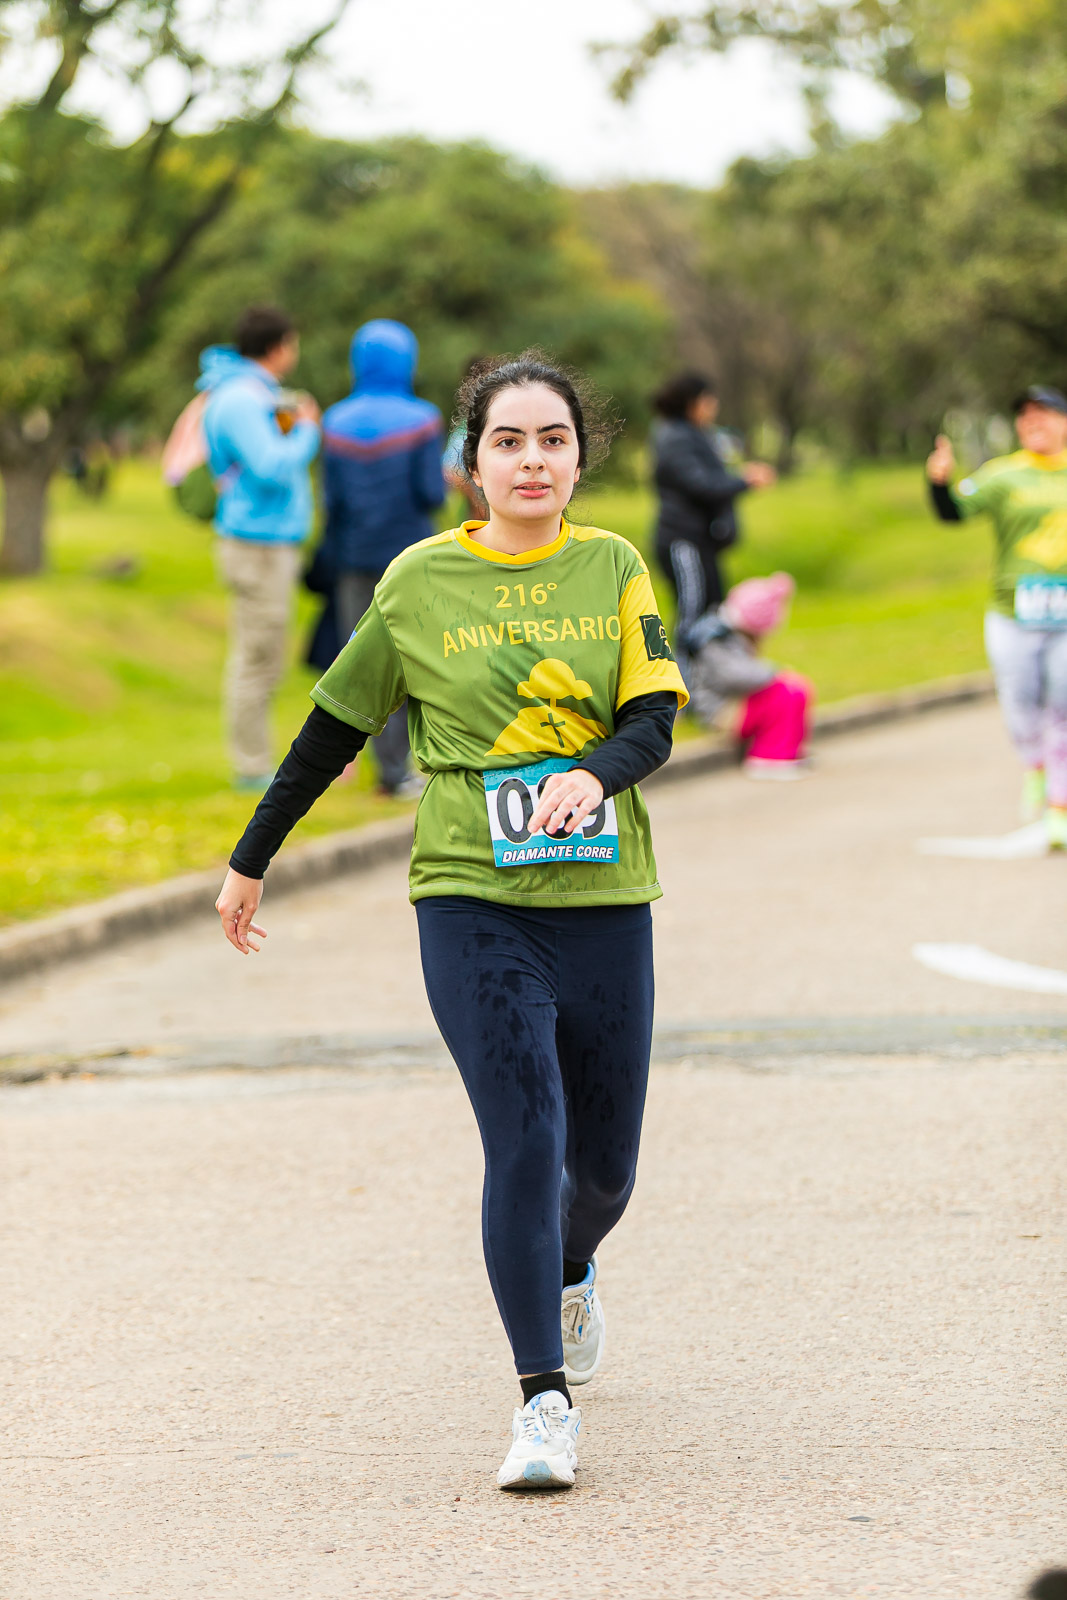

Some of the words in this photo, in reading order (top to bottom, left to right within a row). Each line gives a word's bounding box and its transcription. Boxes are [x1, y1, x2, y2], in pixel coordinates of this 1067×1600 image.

[494, 582, 557, 608] 216°
[443, 615, 621, 657] ANIVERSARIO
[502, 845, 573, 863] DIAMANTE
[576, 846, 614, 859] CORRE
